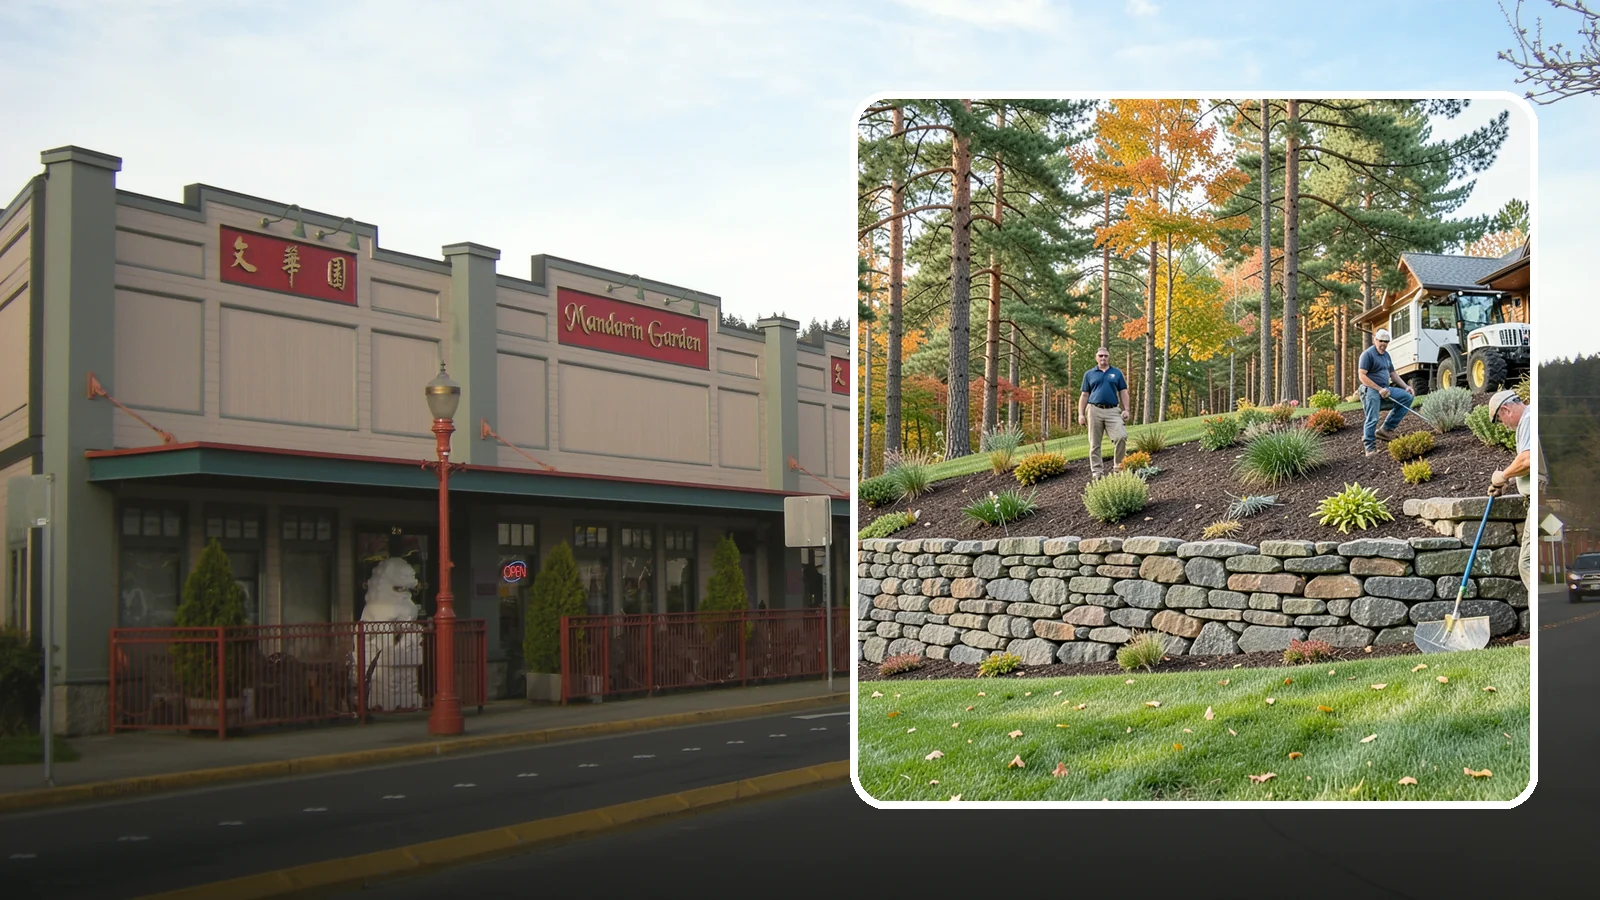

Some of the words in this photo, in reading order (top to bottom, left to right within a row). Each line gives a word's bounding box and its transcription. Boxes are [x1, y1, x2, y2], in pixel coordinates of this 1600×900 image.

[230, 235, 346, 291] 文華園
[564, 302, 644, 341] Mandarin
[647, 320, 702, 352] Garden
[503, 565, 527, 578] OPEN
